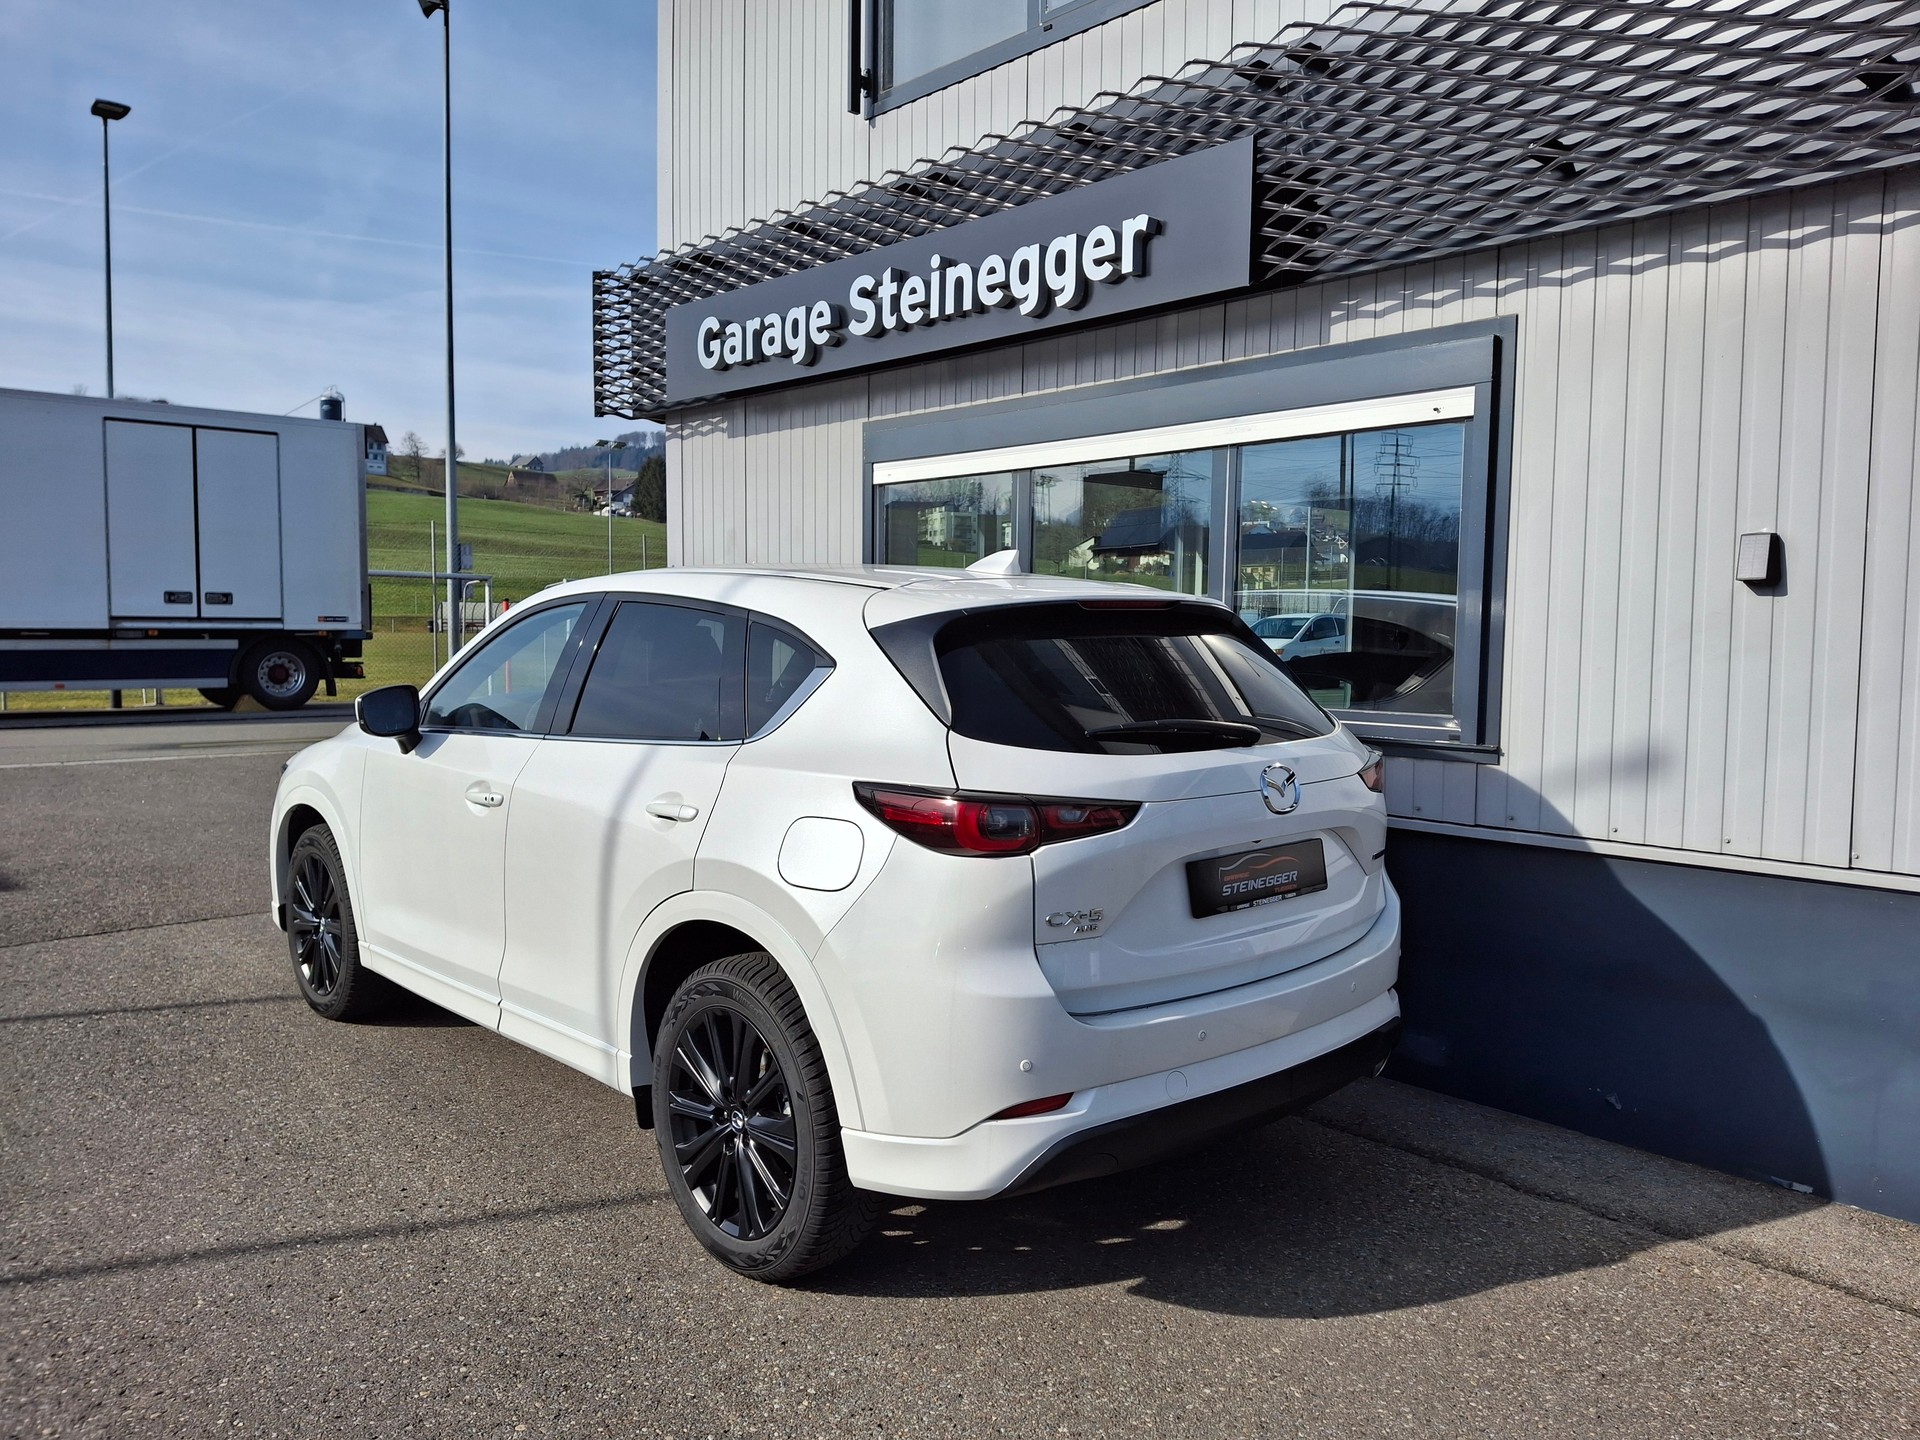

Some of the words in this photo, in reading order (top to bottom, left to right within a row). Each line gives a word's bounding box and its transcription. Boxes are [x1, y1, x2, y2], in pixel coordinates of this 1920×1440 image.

[697, 300, 833, 371] Garage
[848, 213, 1155, 337] Steinegger
[1222, 870, 1298, 896] STEINEGGER
[1045, 906, 1104, 927] CX-5
